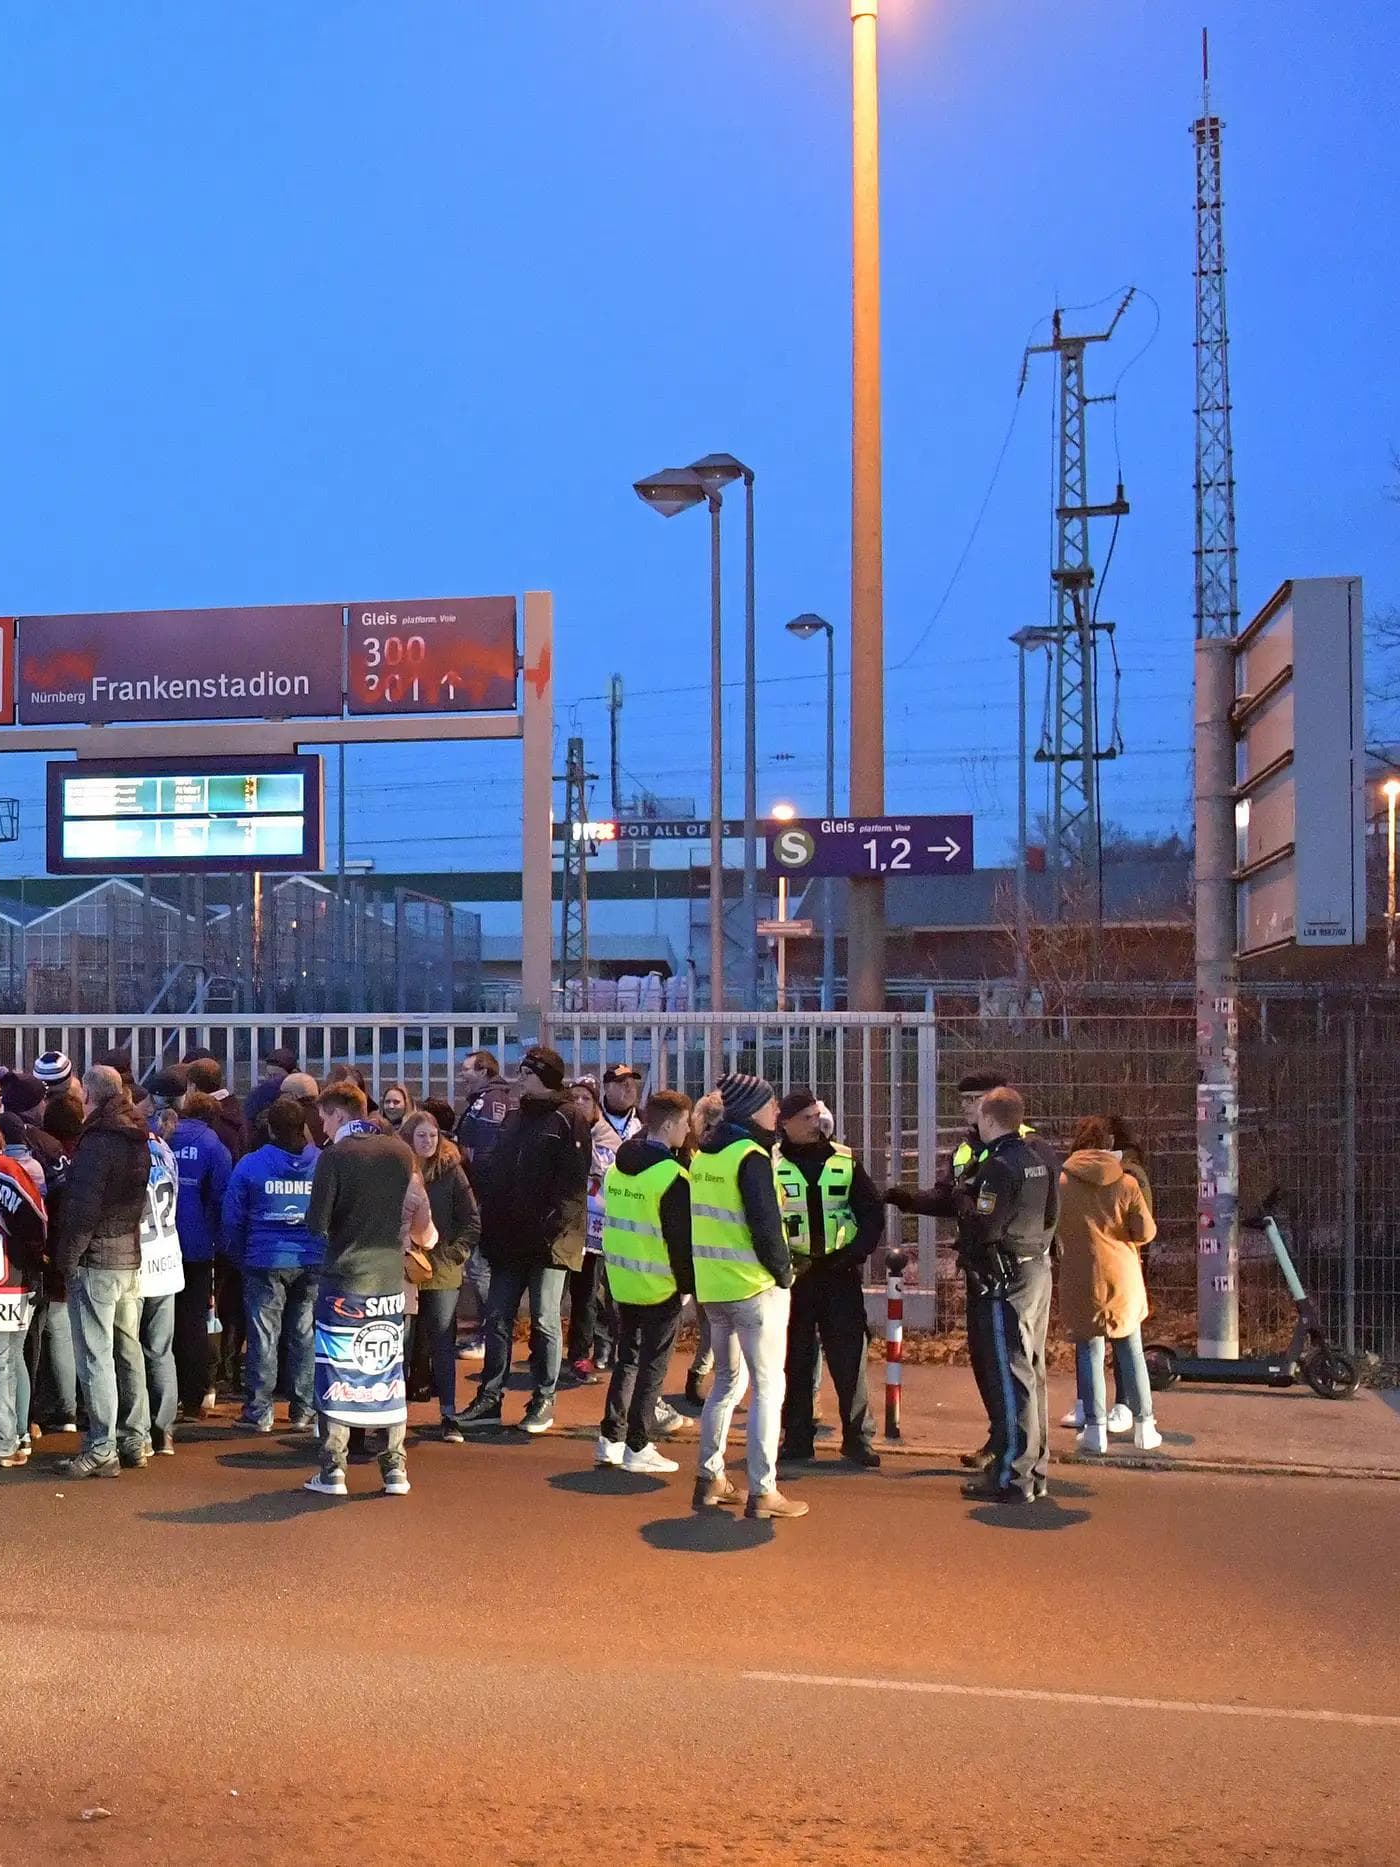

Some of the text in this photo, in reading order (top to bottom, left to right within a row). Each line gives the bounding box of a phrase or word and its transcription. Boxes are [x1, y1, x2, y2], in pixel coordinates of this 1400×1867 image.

[361, 612, 397, 626] Gleis
[362, 635, 426, 667] 300
[31, 671, 309, 705] Nürnberg Frankenstadion
[620, 825, 649, 837] FOR
[654, 825, 681, 837] ALL
[686, 825, 707, 837] OF
[820, 820, 855, 833] Gleis
[780, 831, 912, 872] S 1,2
[264, 1179, 313, 1195] ORDNE
[365, 1291, 406, 1317] SATU
